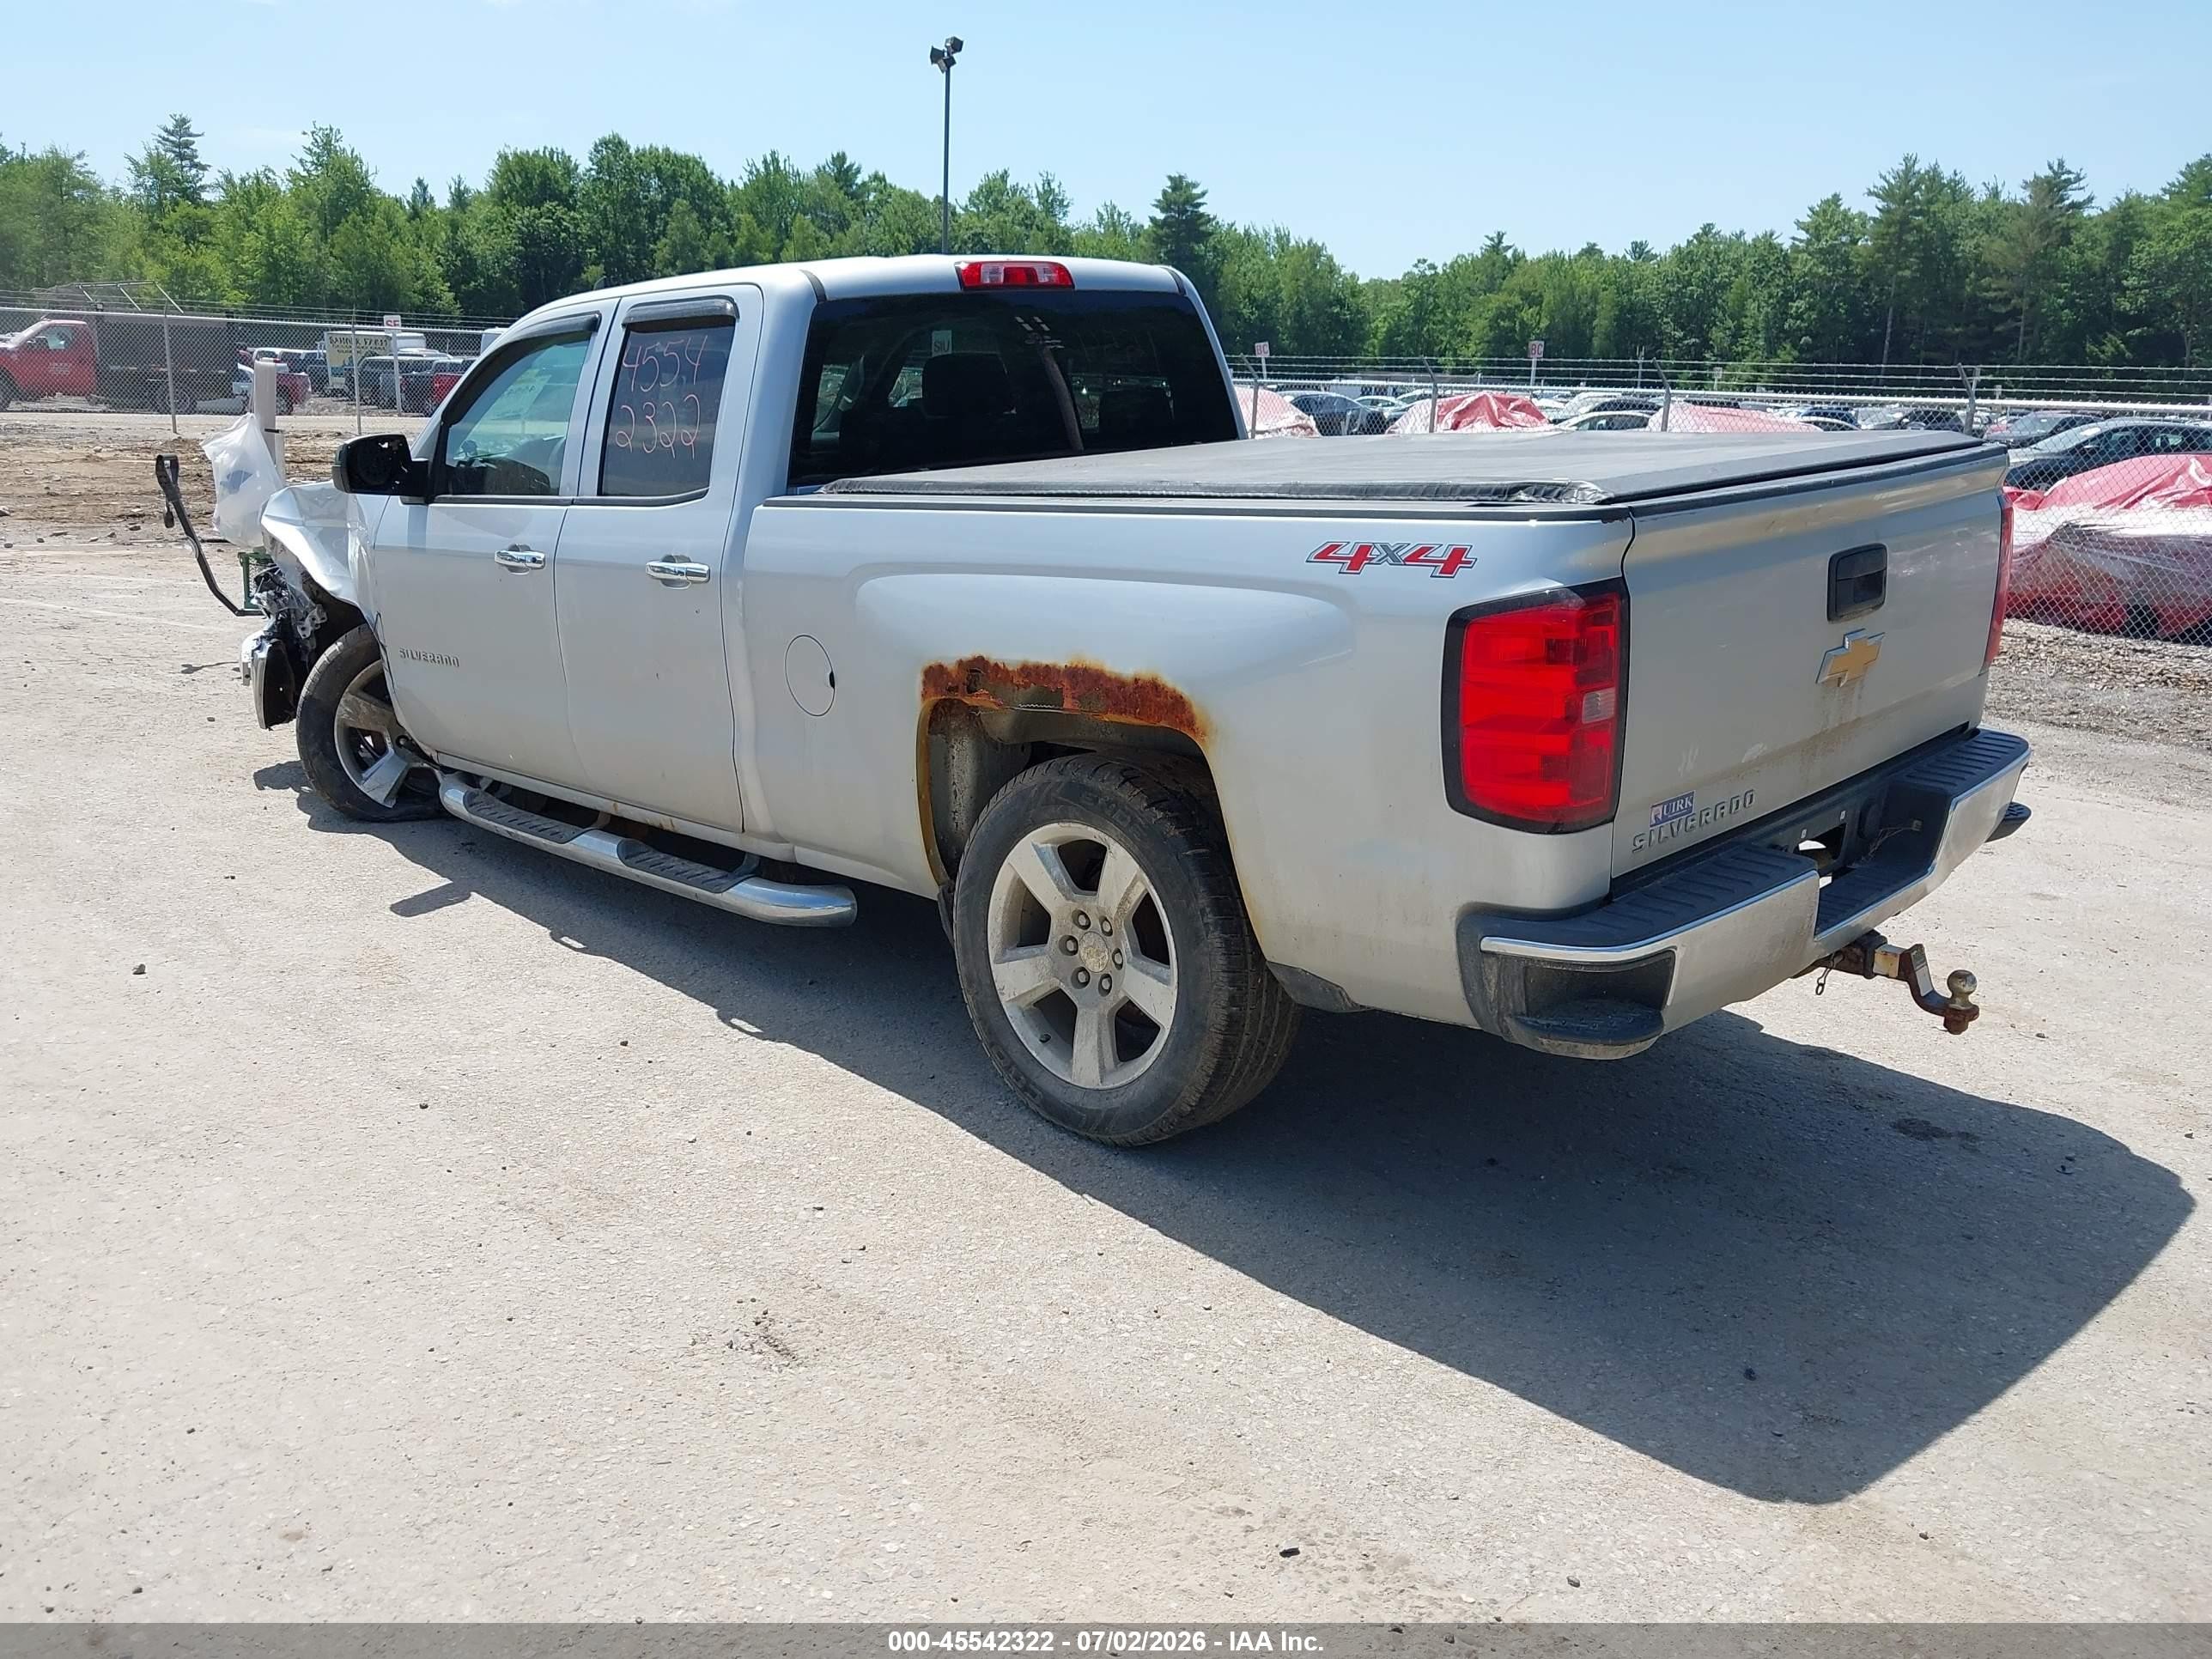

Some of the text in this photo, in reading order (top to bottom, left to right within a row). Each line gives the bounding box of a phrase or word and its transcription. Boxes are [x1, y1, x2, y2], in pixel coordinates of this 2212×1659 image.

[622, 335, 708, 392] 4554
[616, 394, 702, 460] 2322
[399, 648, 459, 667] SILVERADO
[1632, 789, 1756, 854] SILVERADO
[1650, 796, 1693, 827] QUIRK
